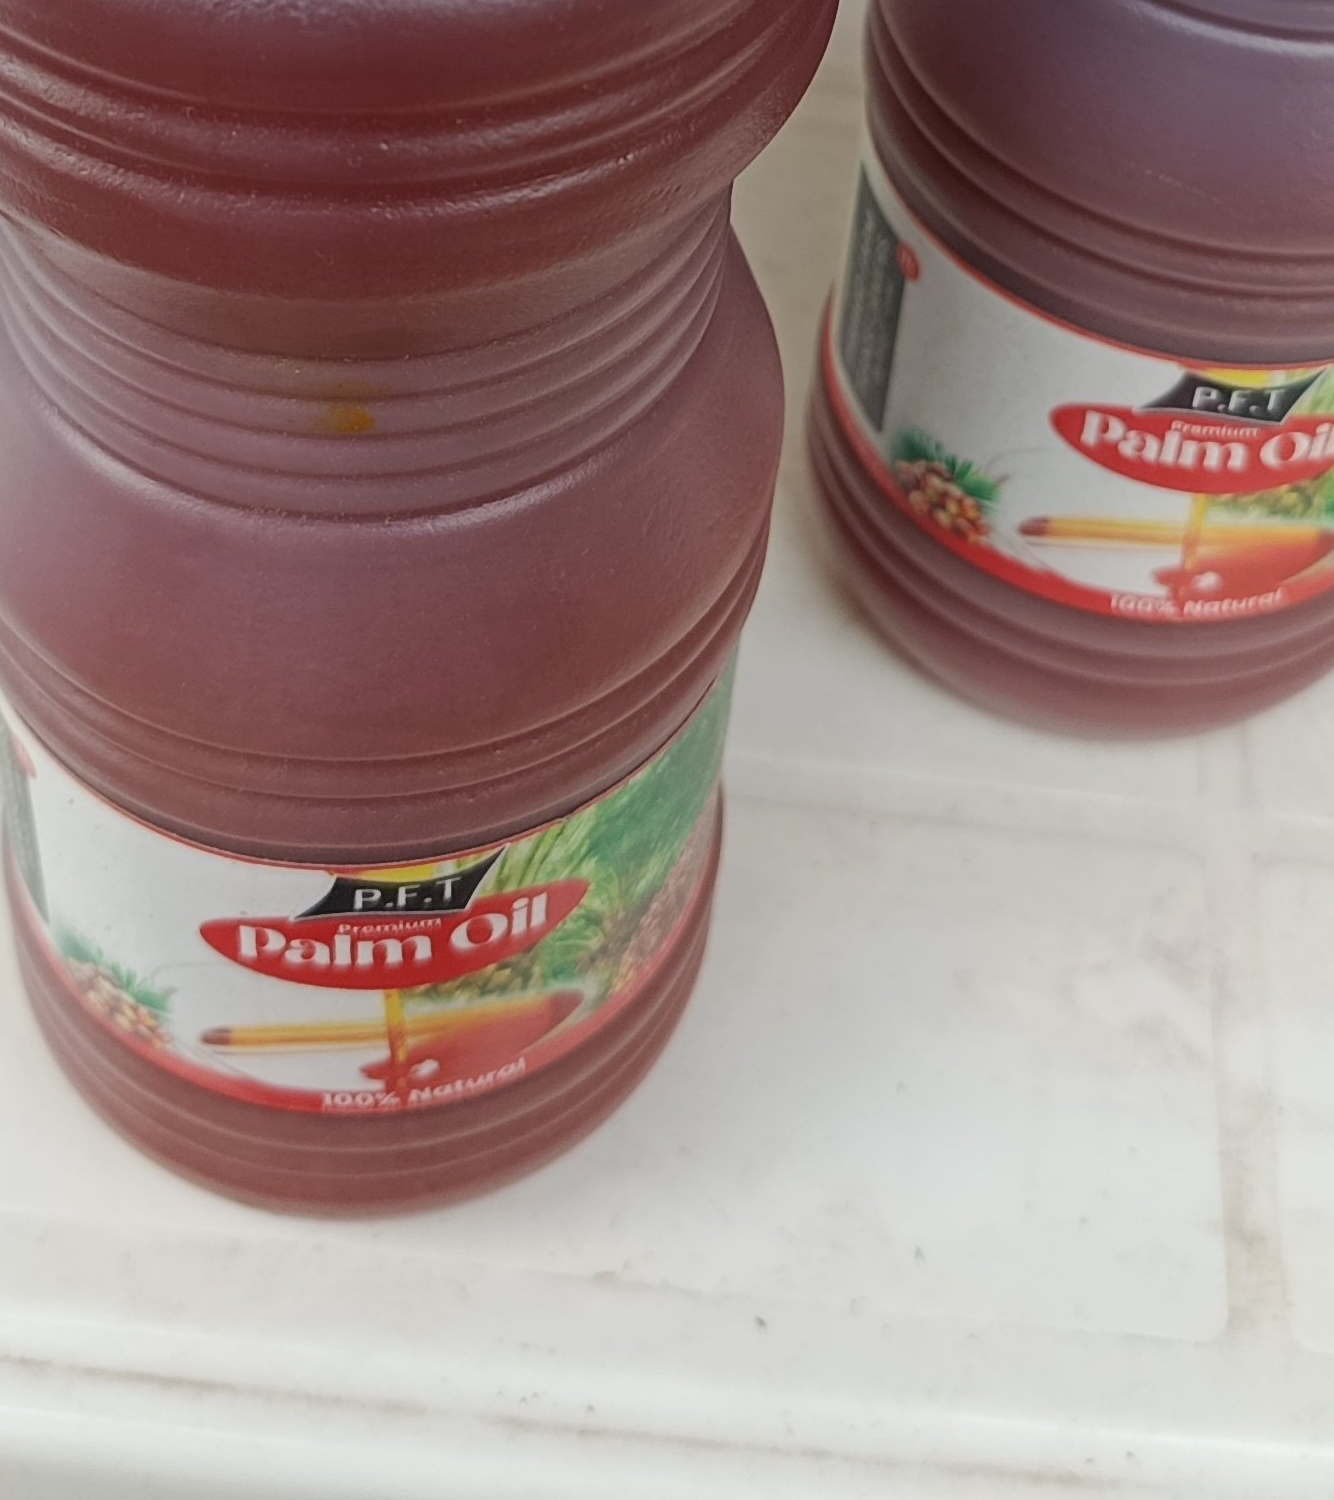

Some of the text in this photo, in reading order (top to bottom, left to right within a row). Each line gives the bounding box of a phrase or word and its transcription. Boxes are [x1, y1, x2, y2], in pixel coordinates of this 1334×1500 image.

[1079, 409, 1250, 473] Palm
[1169, 419, 1260, 438] Premium
[1110, 586, 1284, 617] 100% Natural
[237, 891, 549, 967] Palm Oil
[337, 917, 442, 934] Premium
[321, 1056, 527, 1110] 100% Natural
